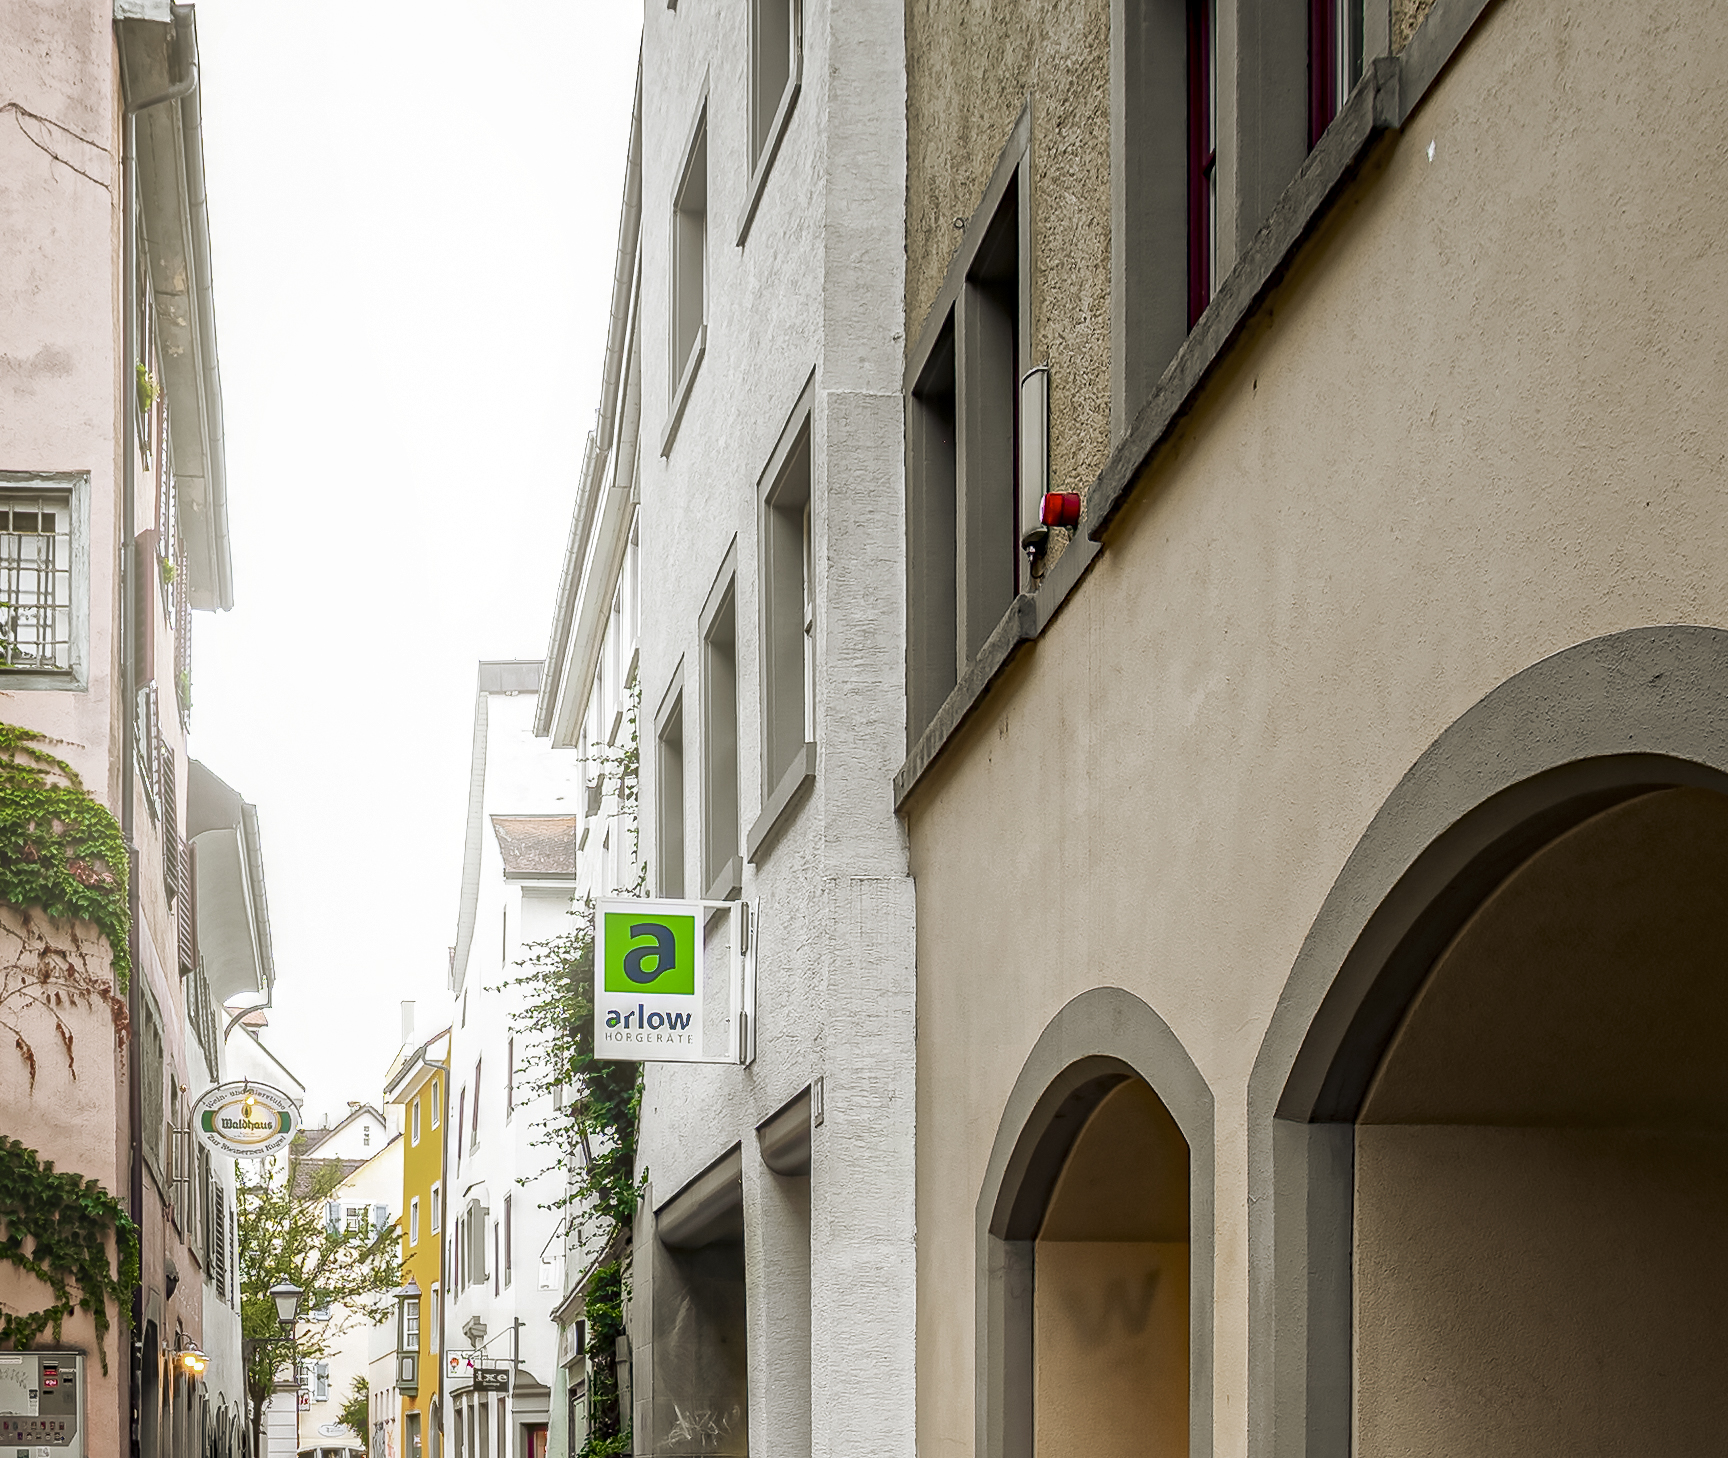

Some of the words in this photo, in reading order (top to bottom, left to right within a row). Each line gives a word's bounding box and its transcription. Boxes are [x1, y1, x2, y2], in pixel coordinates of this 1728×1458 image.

[623, 922, 676, 984] a
[605, 1003, 692, 1031] arlow
[221, 1117, 273, 1131] Waldhaus
